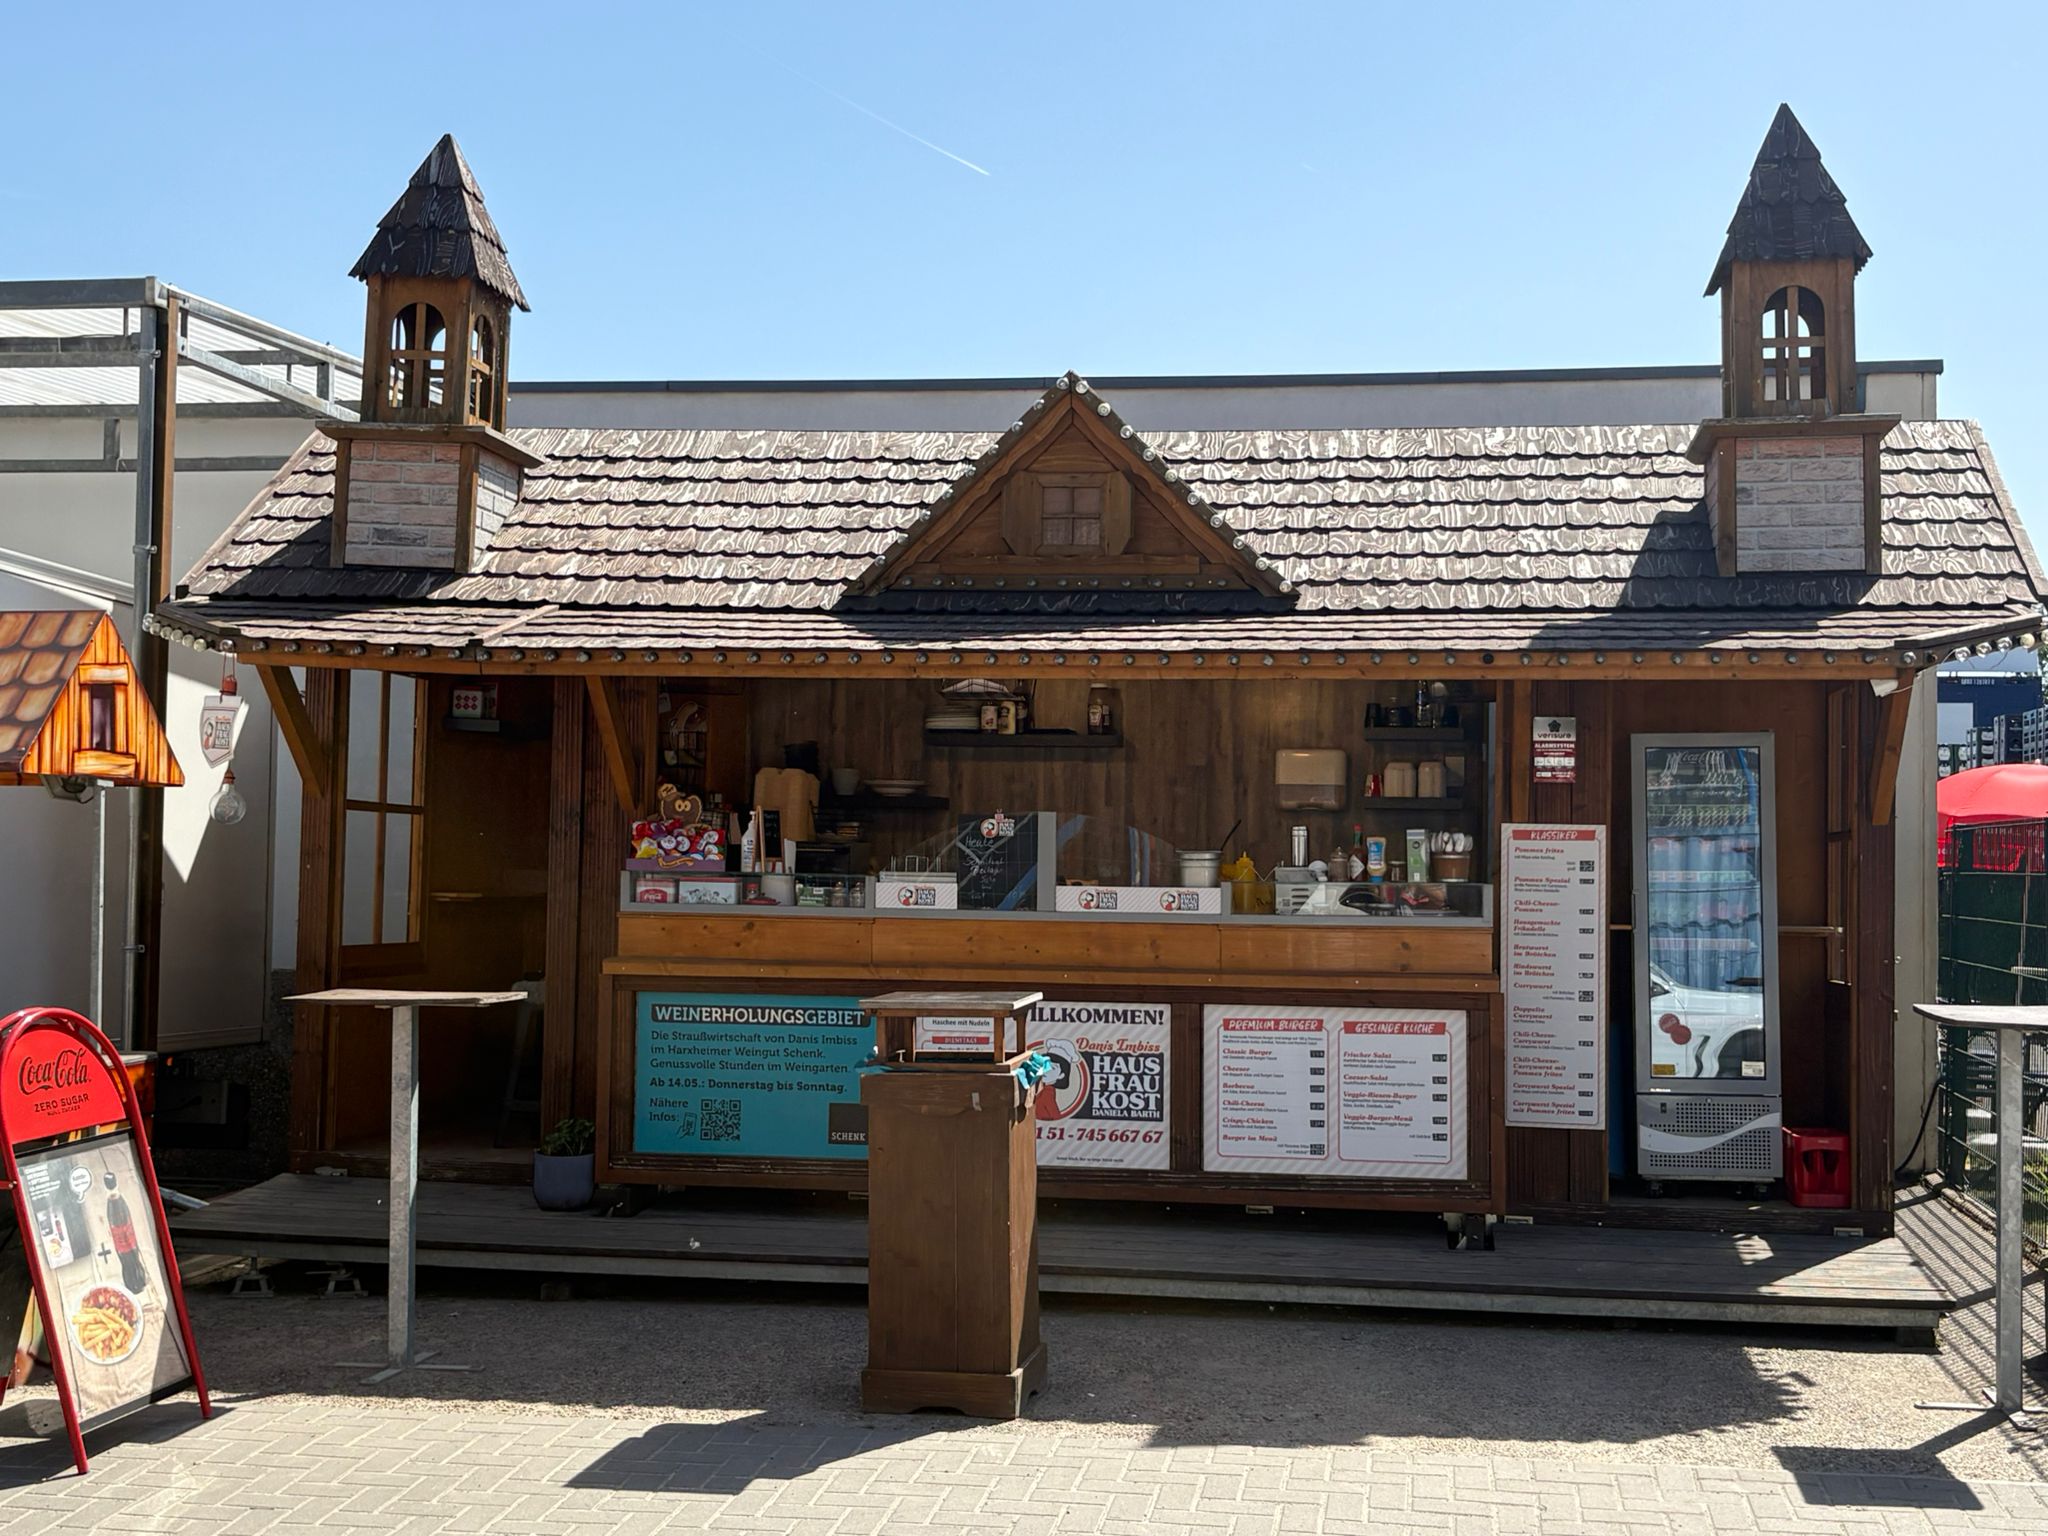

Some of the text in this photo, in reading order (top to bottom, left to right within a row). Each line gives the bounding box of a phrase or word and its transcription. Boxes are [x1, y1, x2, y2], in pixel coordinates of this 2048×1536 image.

[1530, 831, 1578, 840] KLASSIKER
[655, 1005, 865, 1026] WEINERHOLUNGSGEBIET
[1030, 1006, 1164, 1026] ILLKOMMEN!
[1513, 1012, 1553, 1020] Currywurst
[932, 1018, 956, 1027] Haschee
[968, 1019, 991, 1027] Nudeln
[1228, 1019, 1319, 1031] PREMIUM-BURGER
[1355, 1023, 1402, 1033] GESUNDE
[651, 1030, 858, 1045] Die Straußwirtschaft von Danis Imbiss
[651, 1045, 826, 1059] im Harxheimer Weingut Schenk.
[1076, 1037, 1161, 1054] Danis Imbiss
[1248, 1048, 1273, 1056] Burger
[18, 1047, 92, 1096] Coca-Cola
[650, 1059, 850, 1074] Genussvolle Stunden im Weingarten.
[1092, 1055, 1161, 1075] HAUS
[649, 1077, 848, 1093] Ab 14.05.: Donnerstag bis Sonntag.
[1092, 1073, 1161, 1093] FRAU
[34, 1093, 90, 1112] ZERO SUGAR
[649, 1097, 689, 1108] Nähere
[1092, 1092, 1161, 1111] KOST
[1222, 1099, 1265, 1107] Chili-Cheese
[649, 1111, 680, 1122] Infos:
[1092, 1109, 1161, 1119] DANIELA BARTH
[1222, 1117, 1274, 1125] Crispy-Chicken
[831, 1131, 866, 1142] SCHENK
[1142, 1129, 1164, 1144] 67
[1222, 1134, 1246, 1142] Burger
